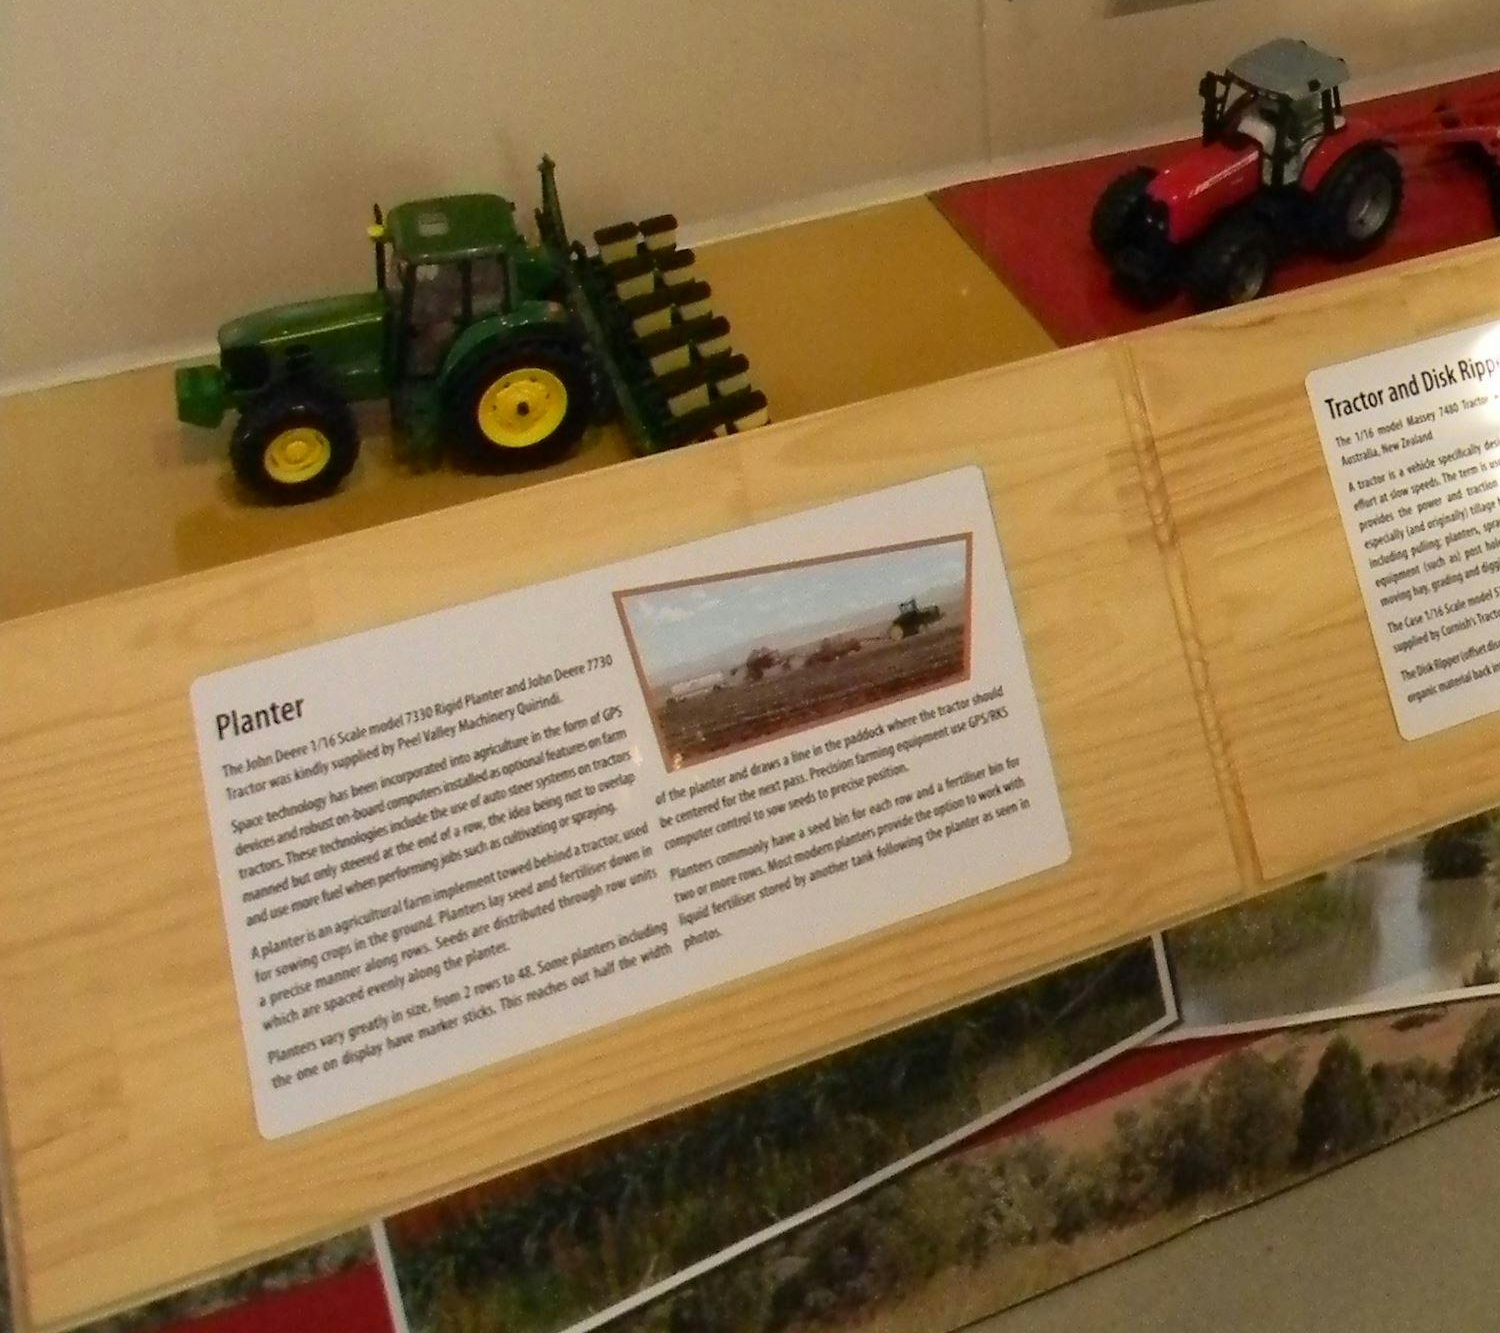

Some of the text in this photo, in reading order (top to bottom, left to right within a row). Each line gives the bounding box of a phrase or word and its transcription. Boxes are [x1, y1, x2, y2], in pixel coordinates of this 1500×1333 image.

[1325, 389, 1384, 420] Tractor
[1388, 374, 1420, 403] and
[1421, 364, 1457, 393] Disk
[215, 698, 304, 740] Planter
